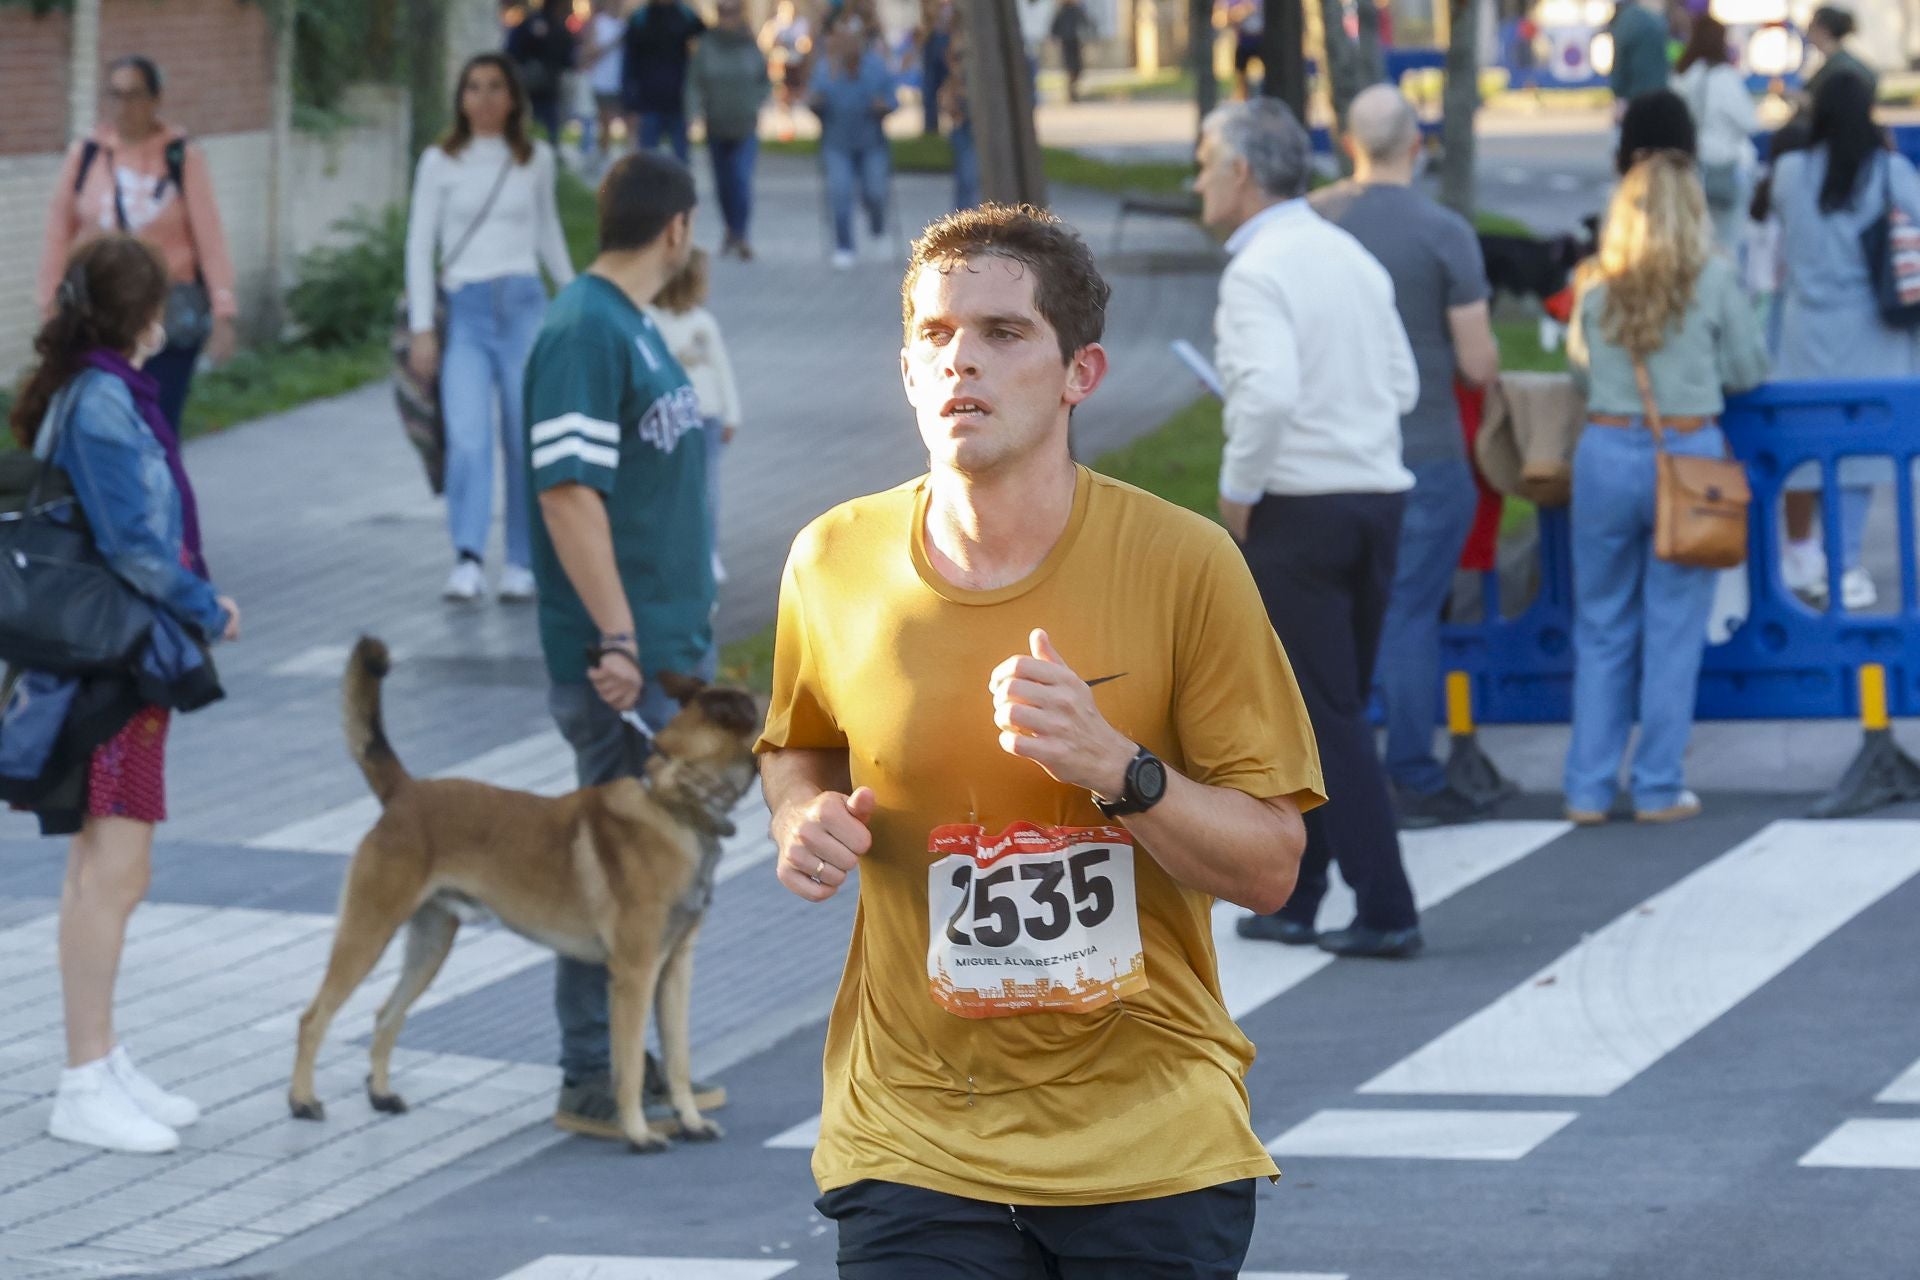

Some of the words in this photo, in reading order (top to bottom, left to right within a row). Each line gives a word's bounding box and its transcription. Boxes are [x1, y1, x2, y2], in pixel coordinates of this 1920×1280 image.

[946, 848, 1115, 948] 2535
[956, 957, 1001, 968] MIGUEL
[1004, 945, 1099, 967] ÁLVAREZ-HEVIA
